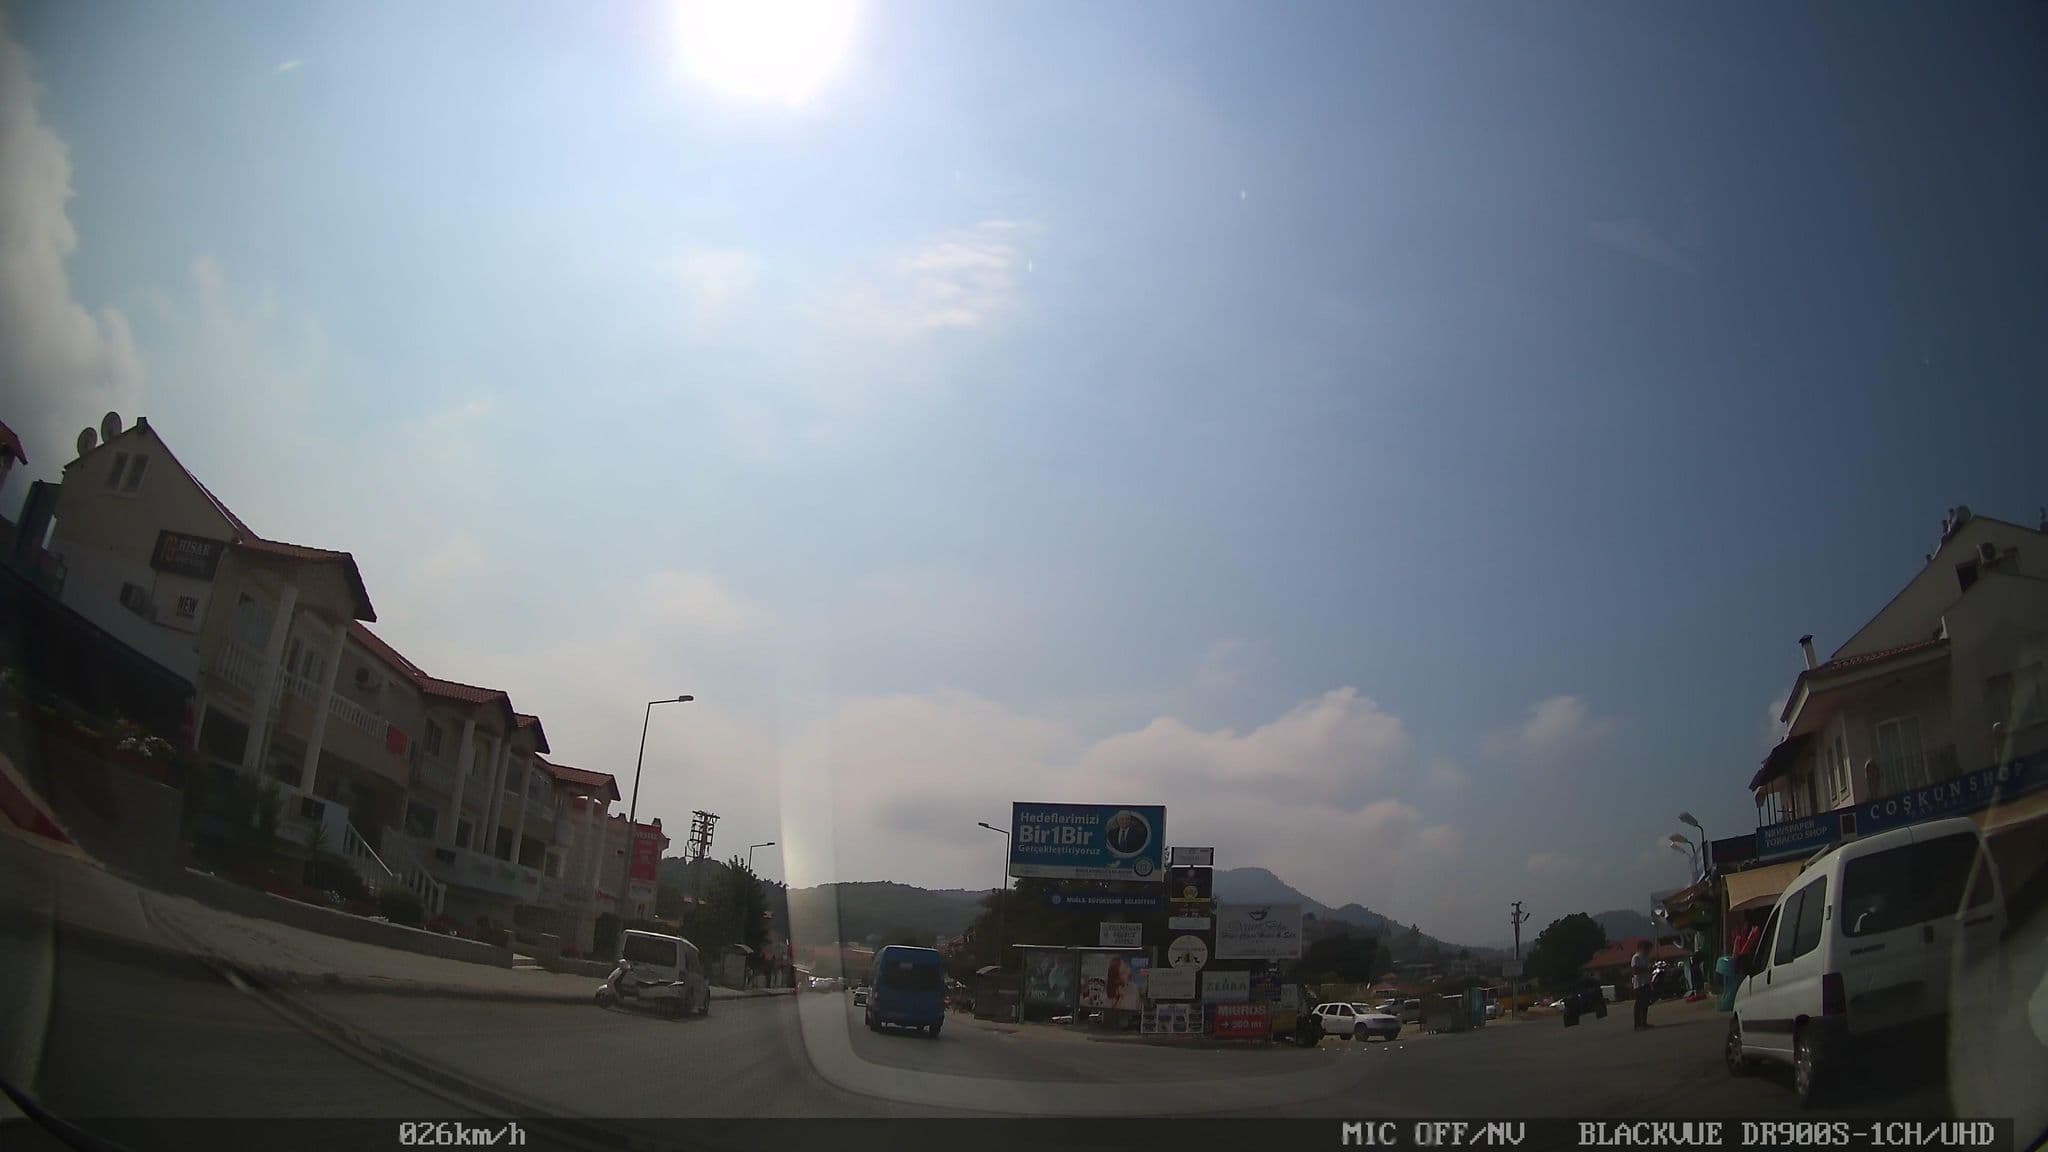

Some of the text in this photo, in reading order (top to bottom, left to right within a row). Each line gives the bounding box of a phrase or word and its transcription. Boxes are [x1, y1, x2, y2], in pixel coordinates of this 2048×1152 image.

[177, 595, 199, 614] NEW
[1020, 811, 1100, 825] Hedeflerimizi
[1019, 824, 1094, 845] Bir1Bir
[1764, 819, 1815, 838] NEWSPAPER
[1764, 826, 1828, 848] TOBACCO SHOP
[1018, 844, 1101, 856] Gerçekleştiriyoruz
